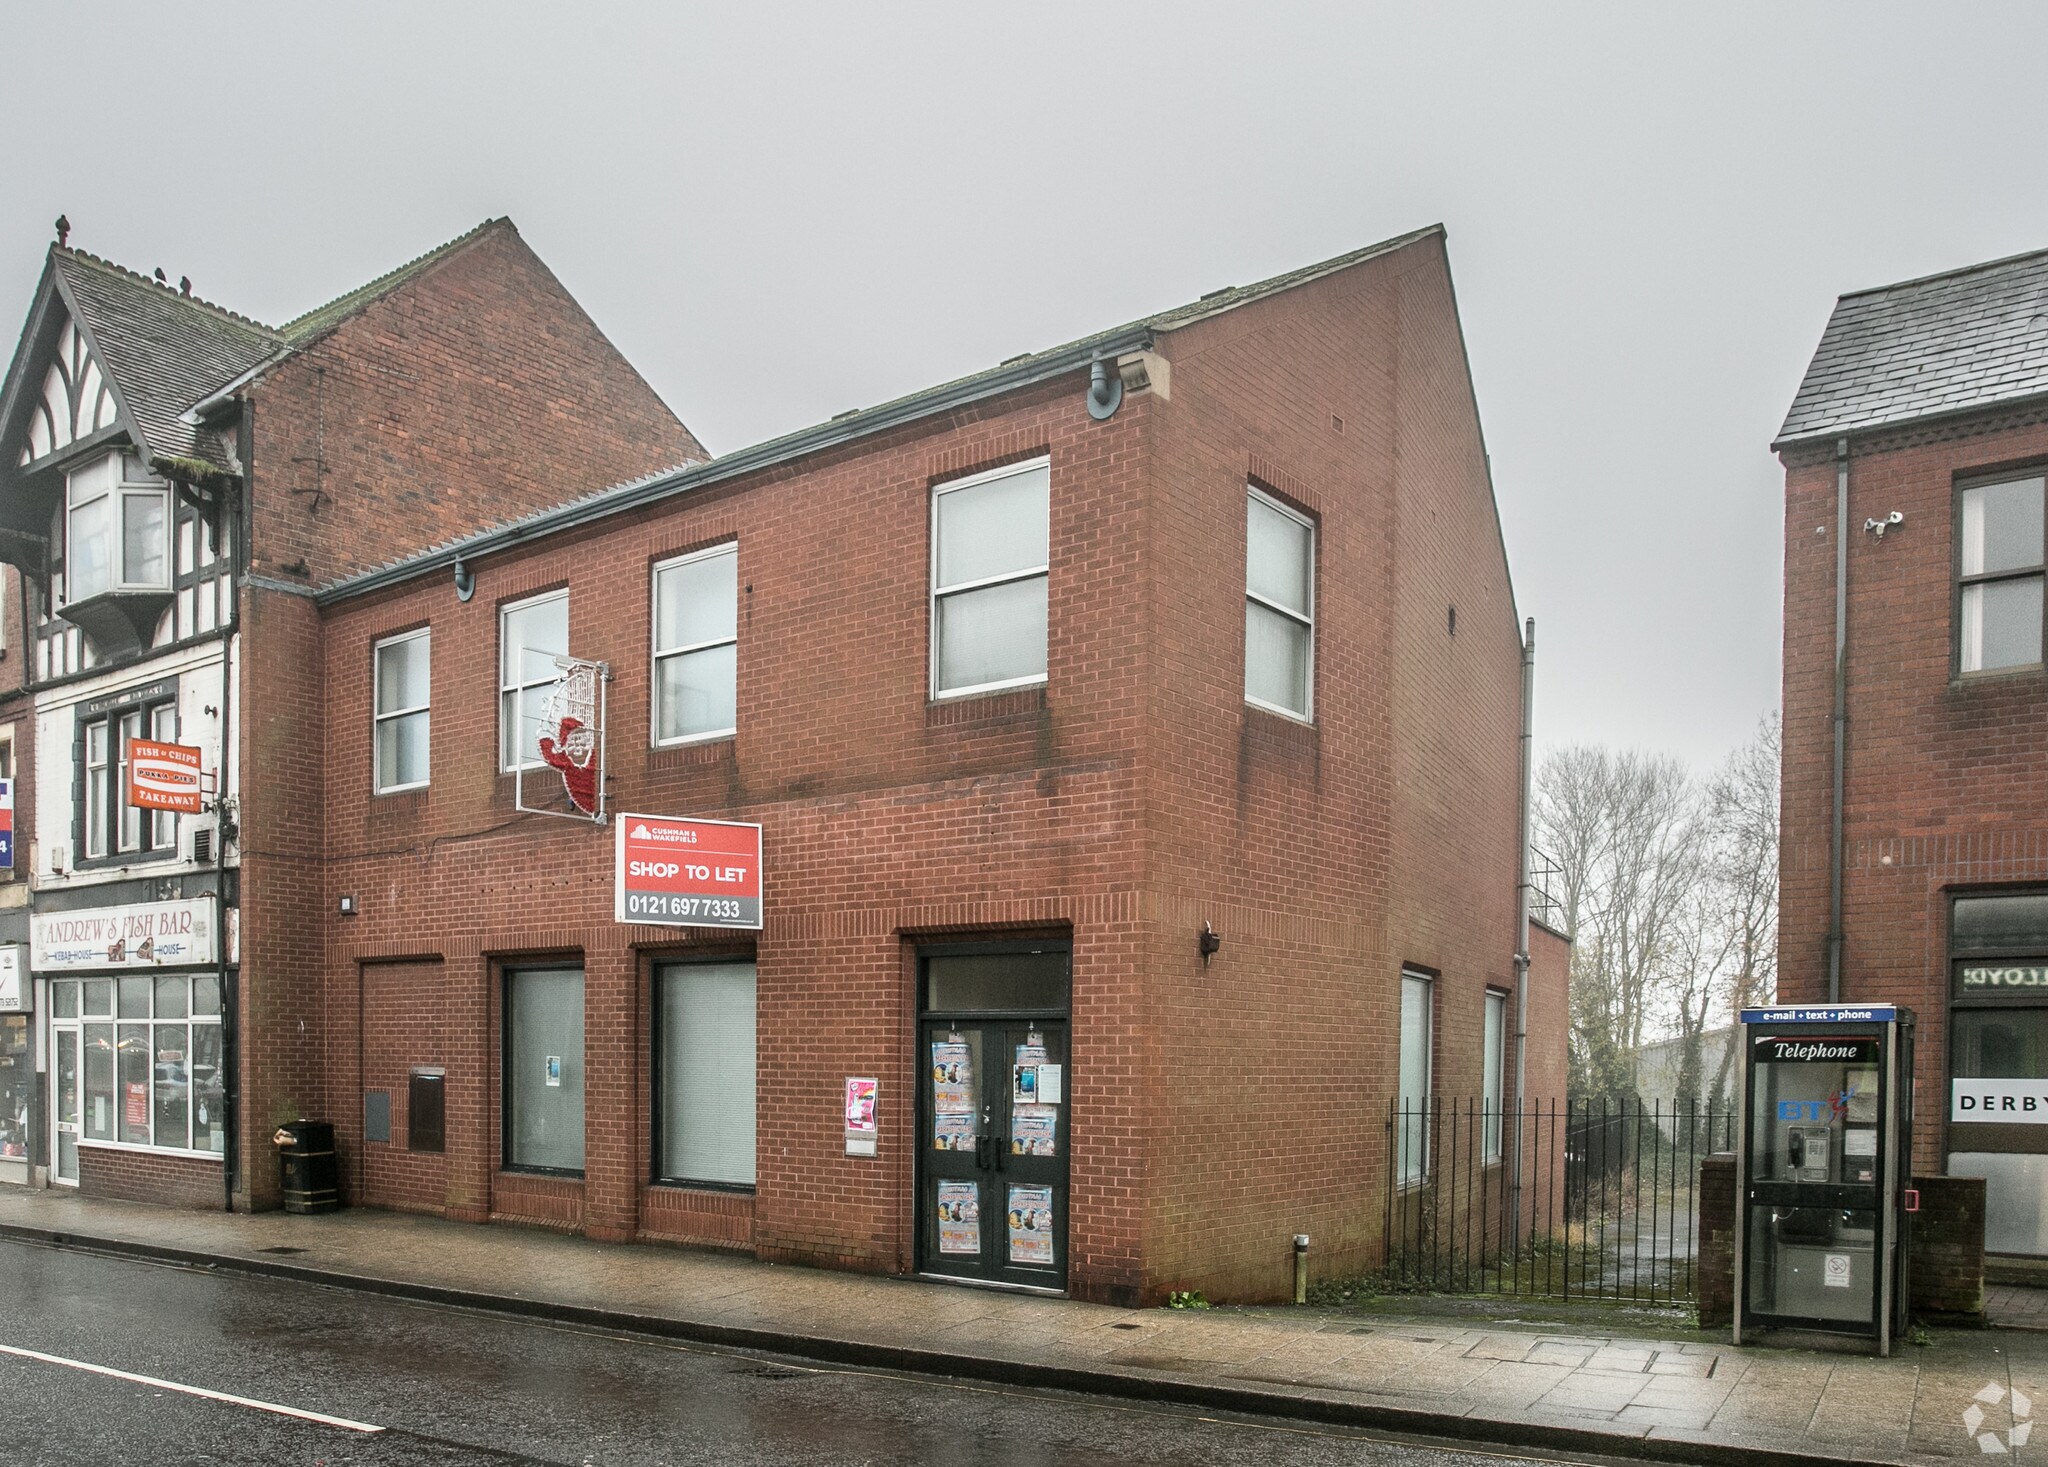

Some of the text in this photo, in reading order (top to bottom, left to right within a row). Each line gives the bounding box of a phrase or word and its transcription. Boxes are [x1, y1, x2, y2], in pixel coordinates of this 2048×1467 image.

[136, 747, 159, 757] FISH
[168, 750, 198, 764] CHIPS
[139, 769, 194, 783] PUKKA PIES
[139, 790, 195, 805] TAKEAWAY
[652, 827, 690, 837] CUSHMAN
[652, 834, 697, 844] WAKEFIELD
[629, 860, 747, 883] SHOP TO LET
[629, 894, 740, 918] 0121 697 7333
[46, 917, 117, 944] ANDREW'S
[121, 914, 155, 938] FISH
[158, 910, 192, 936] BAR
[54, 949, 92, 961] KEBAB HOUSE
[158, 944, 180, 956] HOUSE
[1763, 1011, 1796, 1020] e-mail
[1805, 1011, 1828, 1020] text
[1837, 1010, 1872, 1021] phone
[1774, 1042, 1857, 1061] Telephone
[1778, 1100, 1827, 1121] BT
